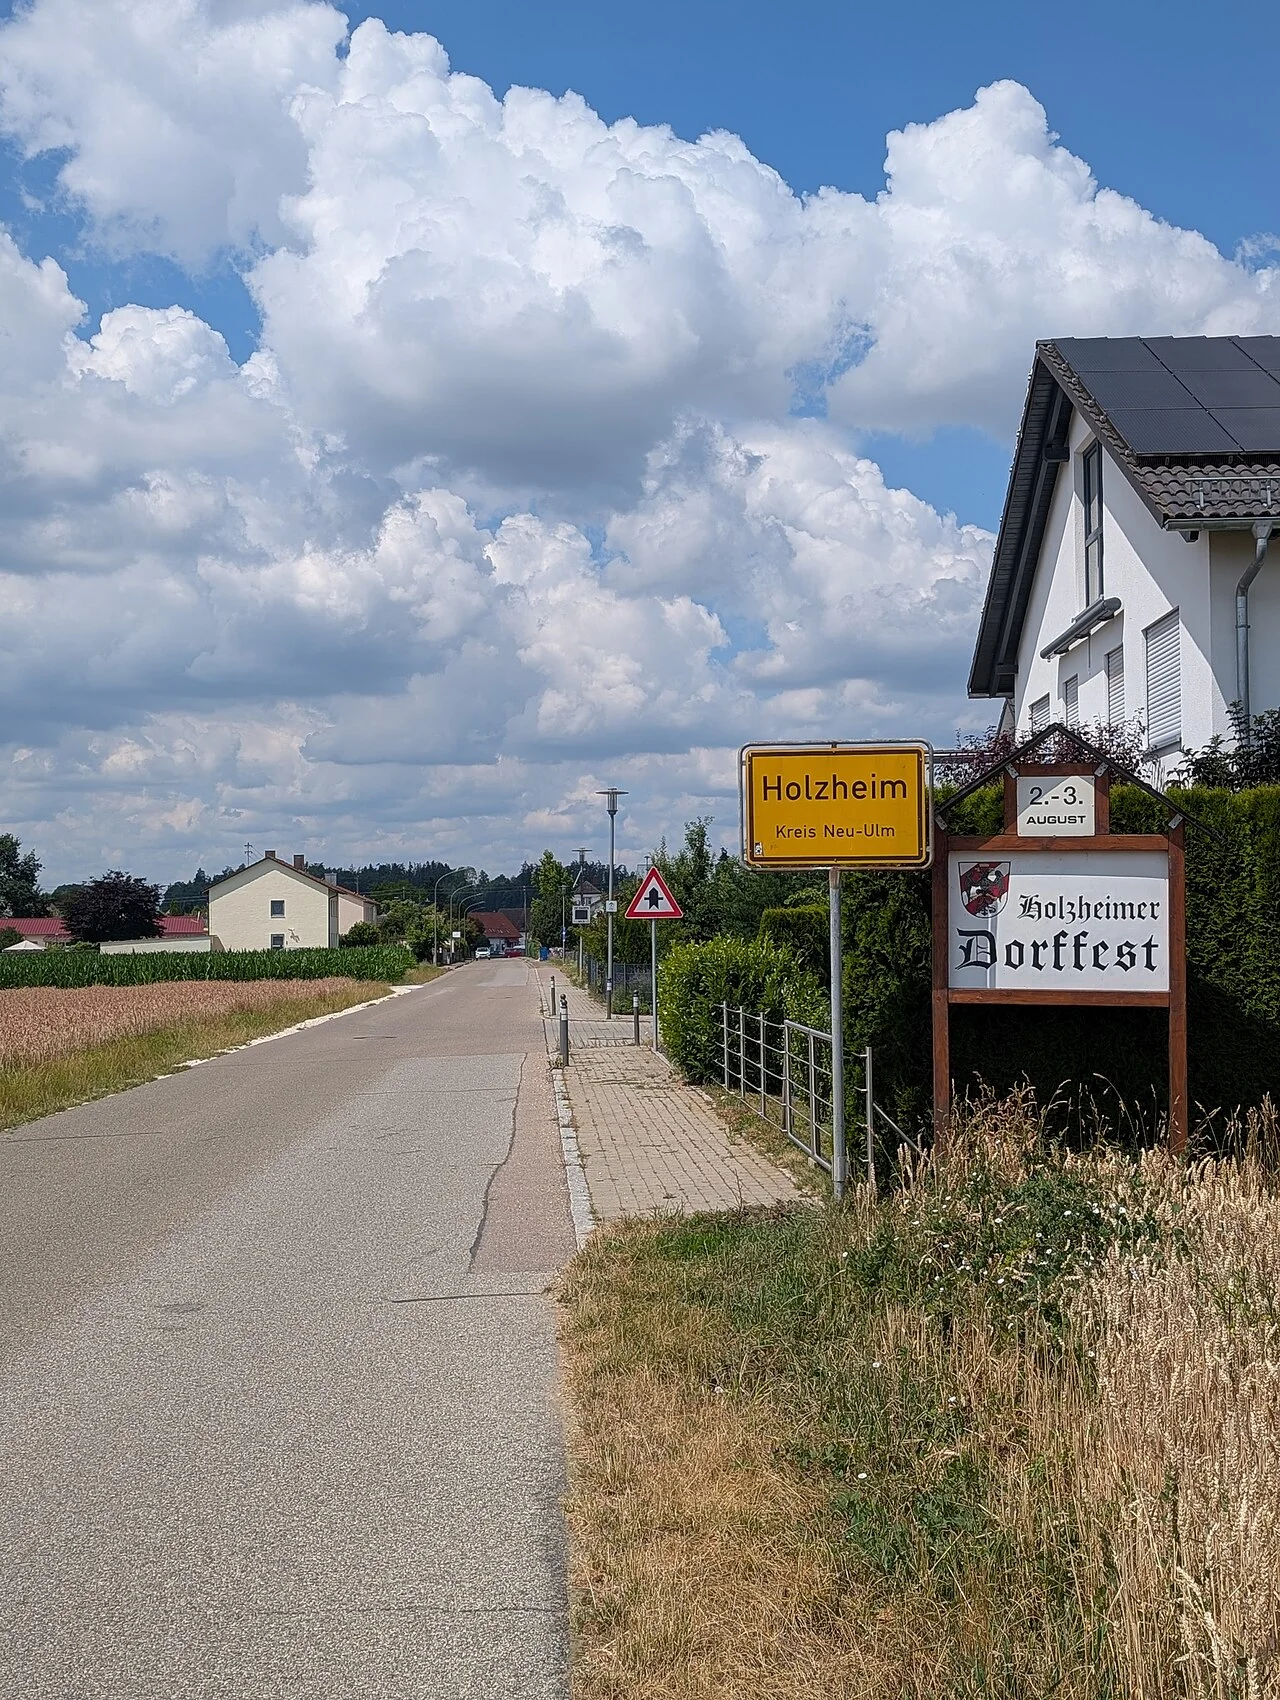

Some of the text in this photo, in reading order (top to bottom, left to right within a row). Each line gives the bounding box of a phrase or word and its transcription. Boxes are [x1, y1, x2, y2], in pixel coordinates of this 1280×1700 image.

[762, 773, 907, 801] Holzheim
[775, 823, 895, 839] Kreis Neu-Ulm
[1026, 815, 1086, 825] AUGUST
[1017, 894, 1161, 925] Holzheimer
[954, 927, 1160, 972] Dorffest
